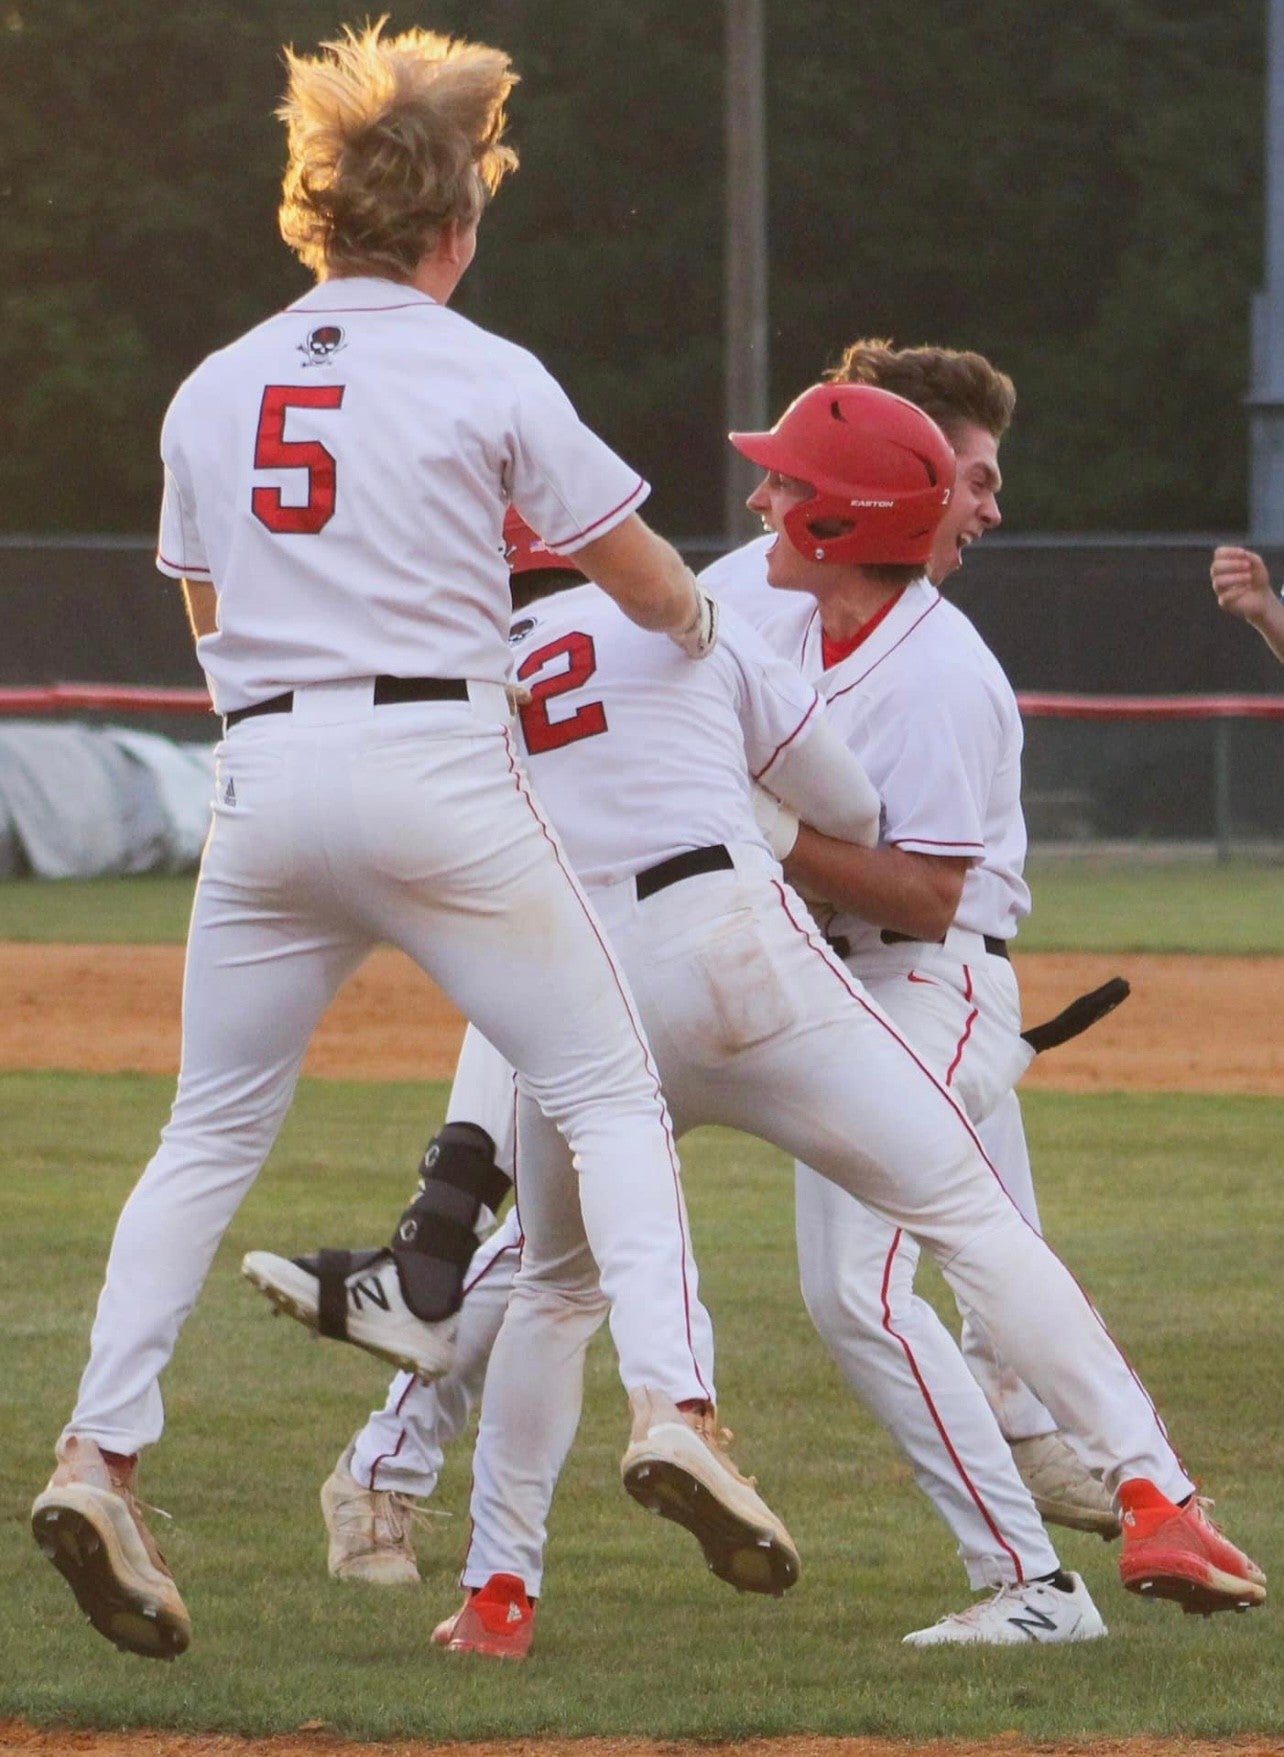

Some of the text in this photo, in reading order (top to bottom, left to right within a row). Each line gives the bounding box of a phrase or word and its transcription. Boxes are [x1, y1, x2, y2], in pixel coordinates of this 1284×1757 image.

[251, 384, 345, 533] 5
[850, 500, 894, 508] EASTON
[942, 488, 950, 505] 2
[517, 631, 608, 755] 2
[350, 1276, 391, 1311] N
[1007, 1606, 1057, 1642] N
